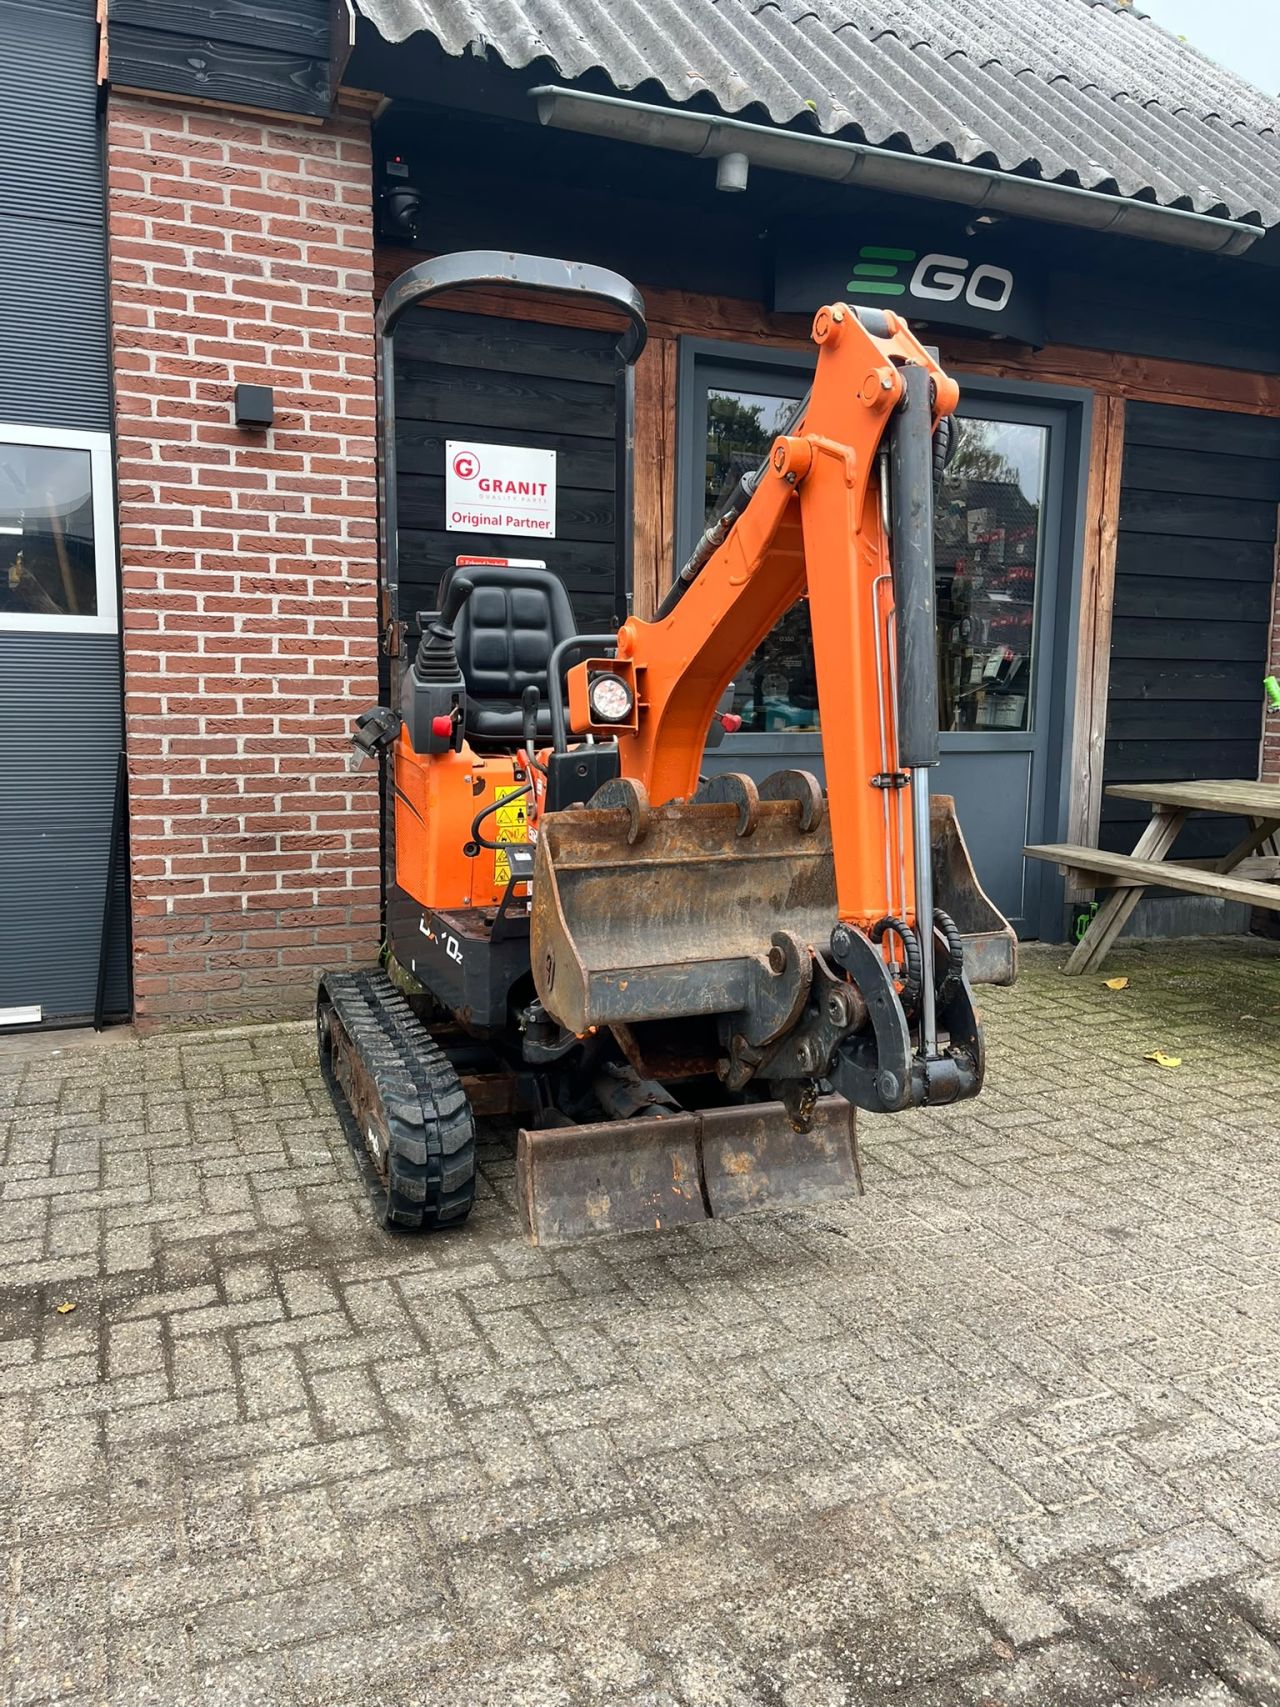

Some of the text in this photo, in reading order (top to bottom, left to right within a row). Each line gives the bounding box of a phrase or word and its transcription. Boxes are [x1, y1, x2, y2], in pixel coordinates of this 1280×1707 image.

[846, 246, 1013, 312] EGO
[478, 478, 547, 496] GRANIT
[452, 512, 550, 529] Original Partner
